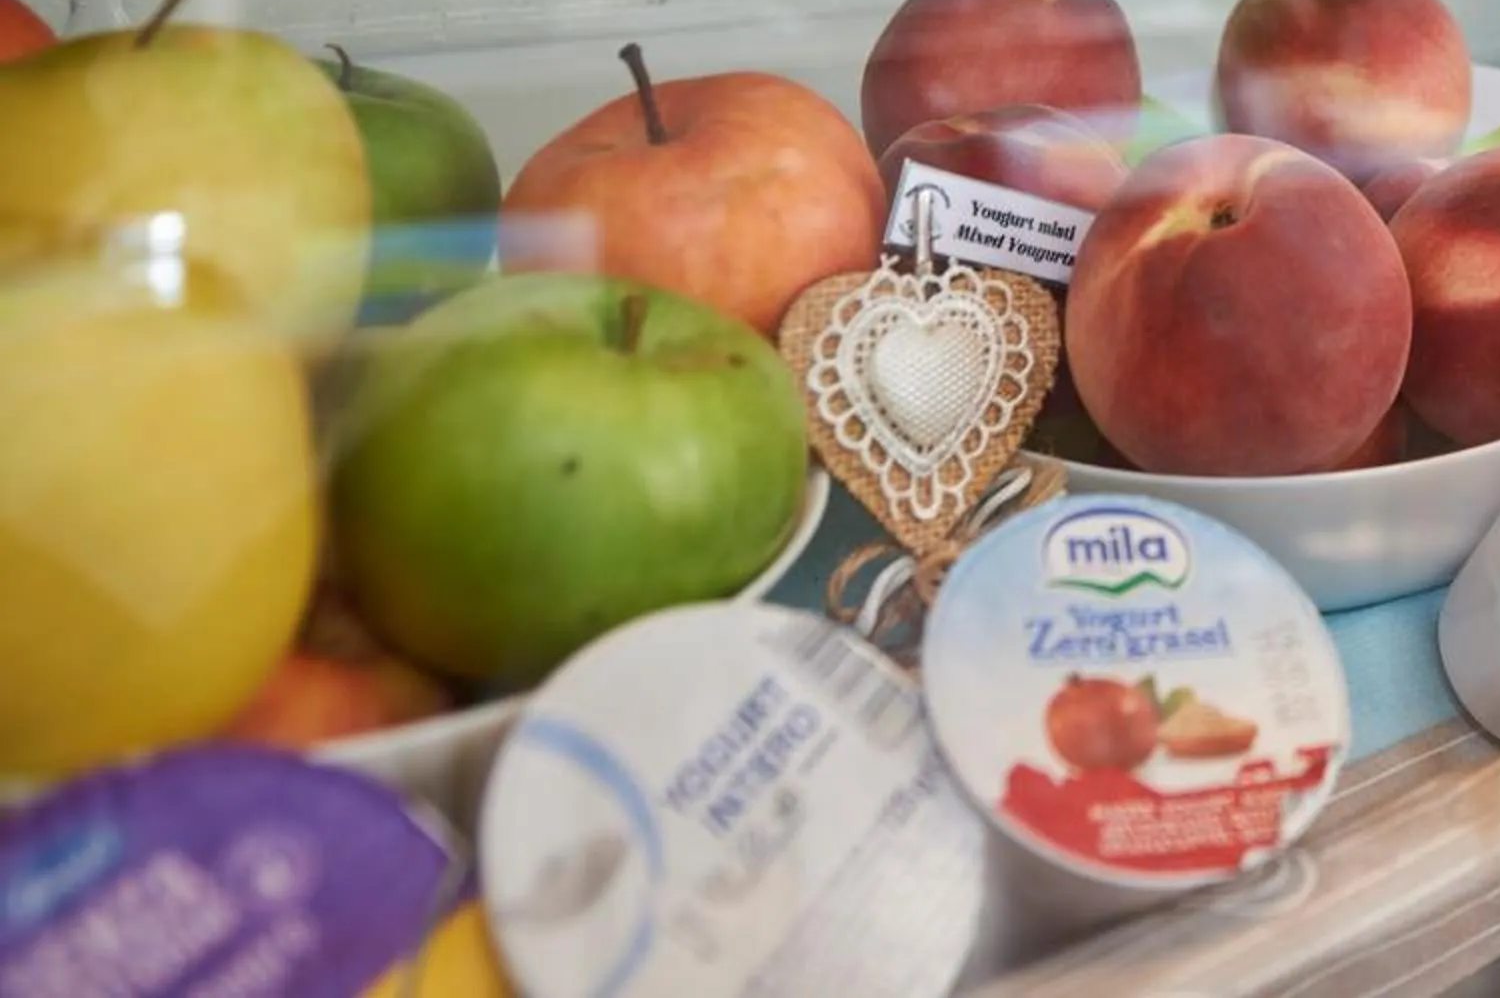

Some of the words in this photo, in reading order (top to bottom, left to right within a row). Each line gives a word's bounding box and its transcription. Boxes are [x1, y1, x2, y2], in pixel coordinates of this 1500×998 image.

[955, 224, 1006, 250] Mixed
[971, 200, 1035, 229] Yougurt
[1037, 221, 1077, 242] misti
[1066, 525, 1170, 566] mila
